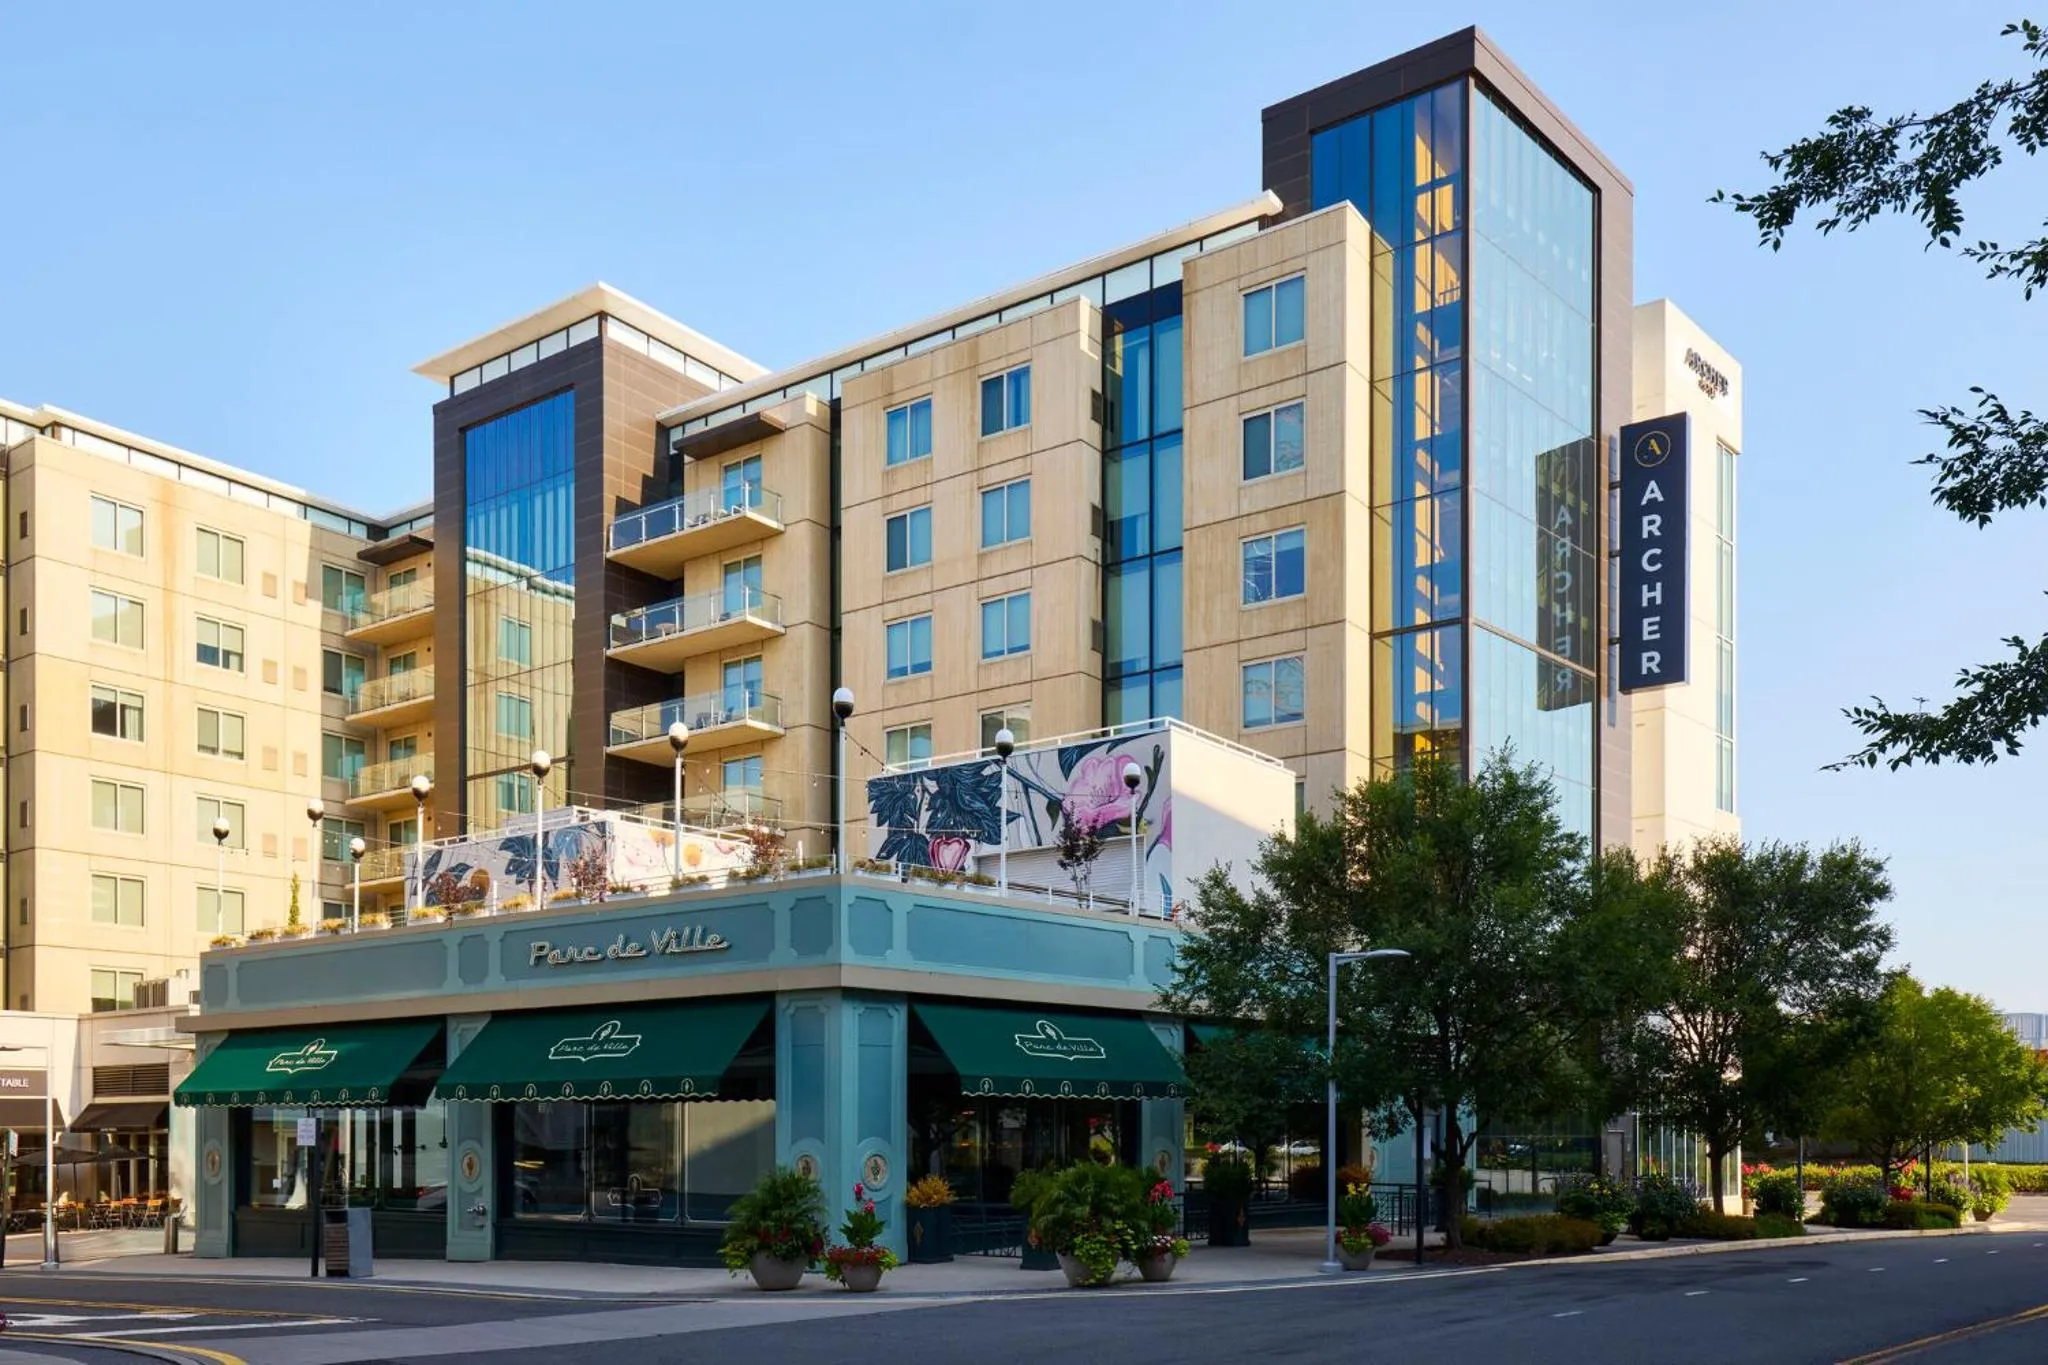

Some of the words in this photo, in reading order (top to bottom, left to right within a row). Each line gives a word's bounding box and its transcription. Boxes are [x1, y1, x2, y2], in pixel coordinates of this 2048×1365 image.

[1640, 480, 1664, 675] ARCHER
[529, 941, 604, 966] Parc
[607, 934, 648, 959] de
[651, 925, 731, 954] Ville
